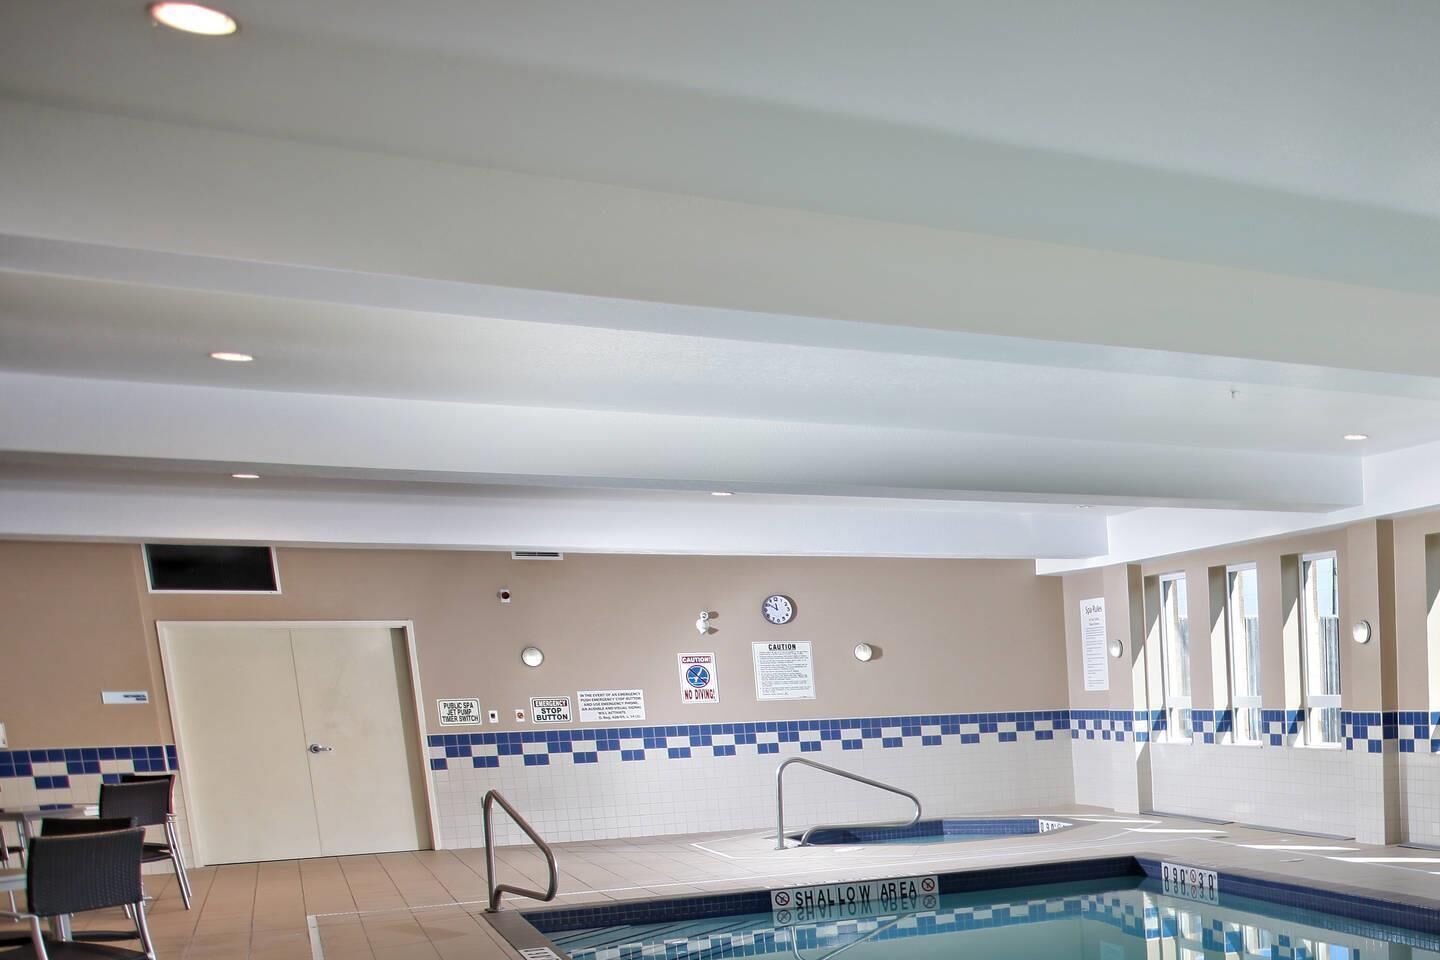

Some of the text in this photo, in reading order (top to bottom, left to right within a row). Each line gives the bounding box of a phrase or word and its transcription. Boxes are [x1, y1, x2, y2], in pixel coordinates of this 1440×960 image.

[685, 689, 715, 700] NO DIVING!
[795, 880, 917, 907] SHALLOW AREA
